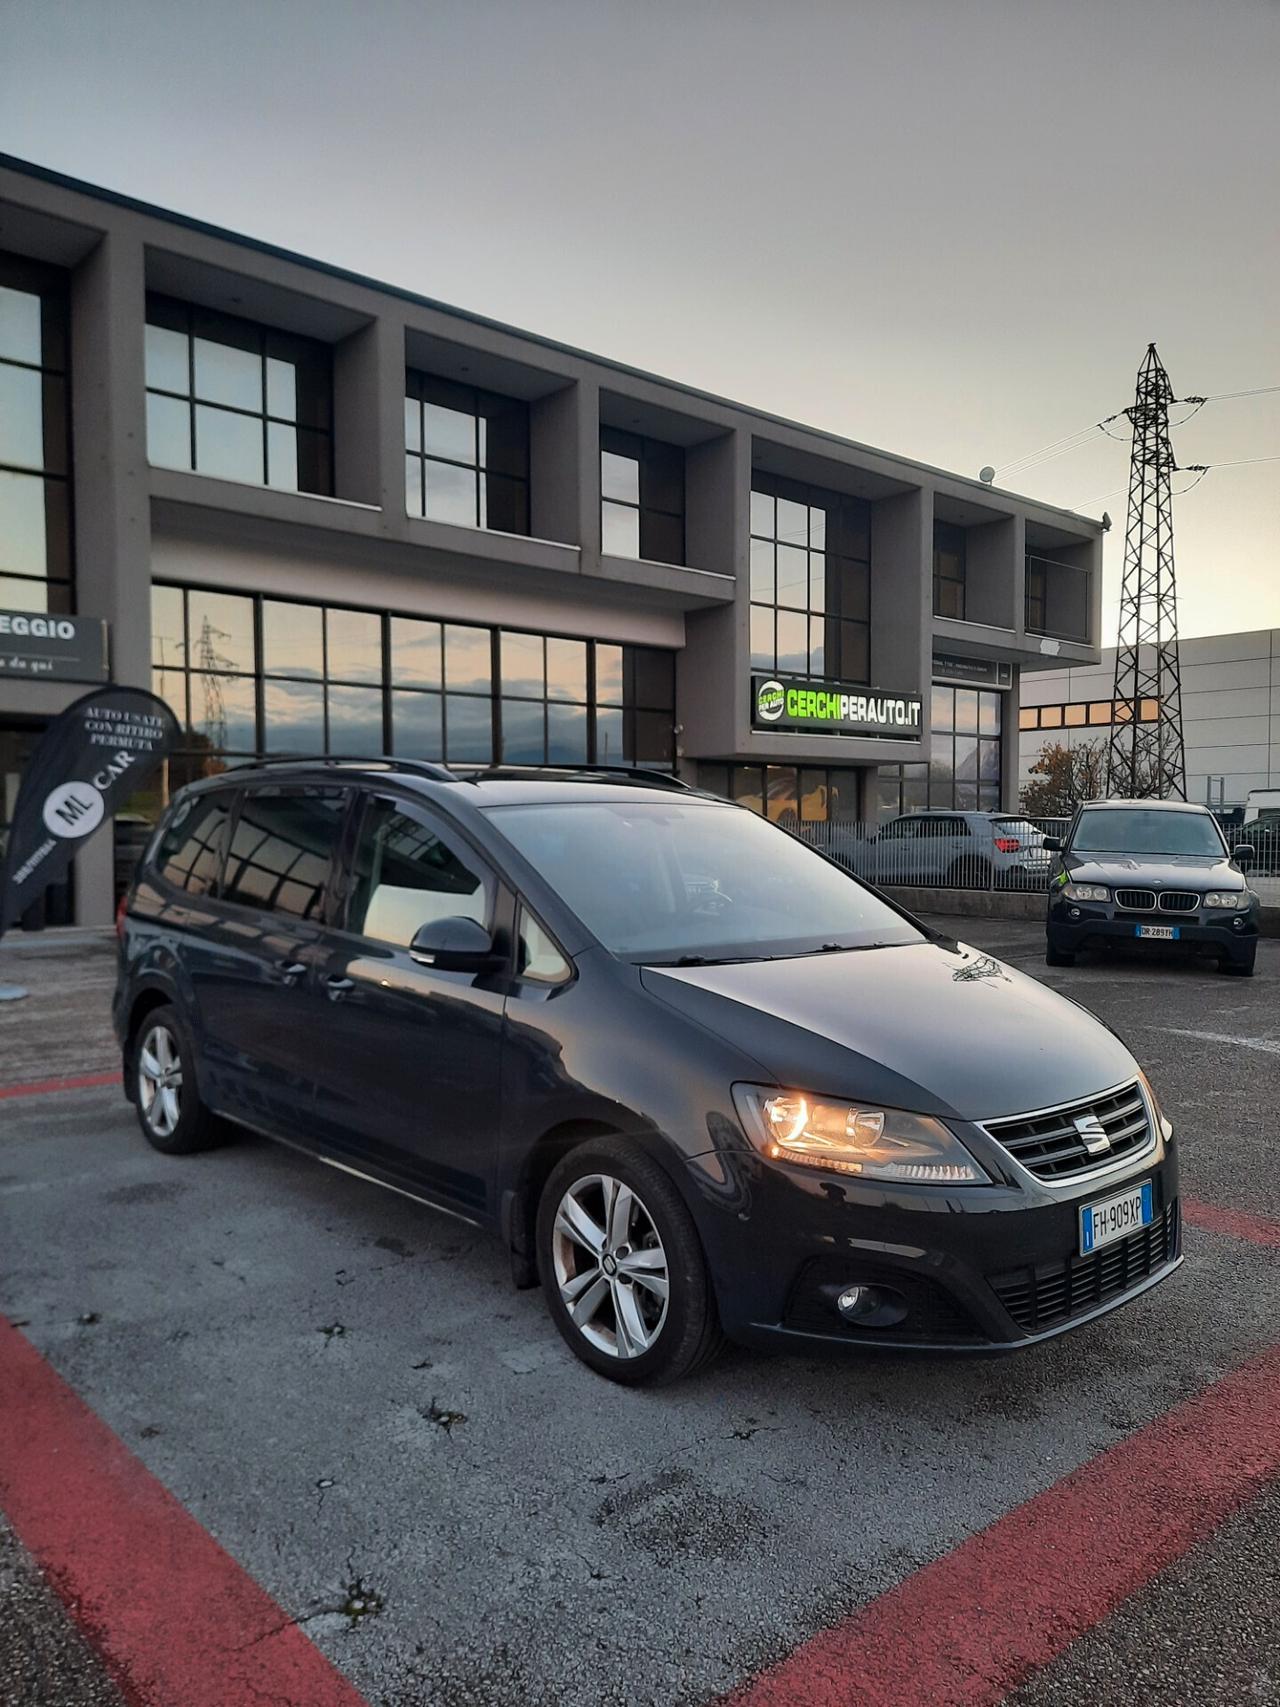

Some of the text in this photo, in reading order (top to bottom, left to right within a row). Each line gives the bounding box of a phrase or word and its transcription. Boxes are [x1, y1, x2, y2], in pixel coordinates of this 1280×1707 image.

[84, 720, 113, 732] CON
[786, 688, 921, 726] CERCHIPERAUTO.IT
[55, 750, 136, 826] ML CAR
